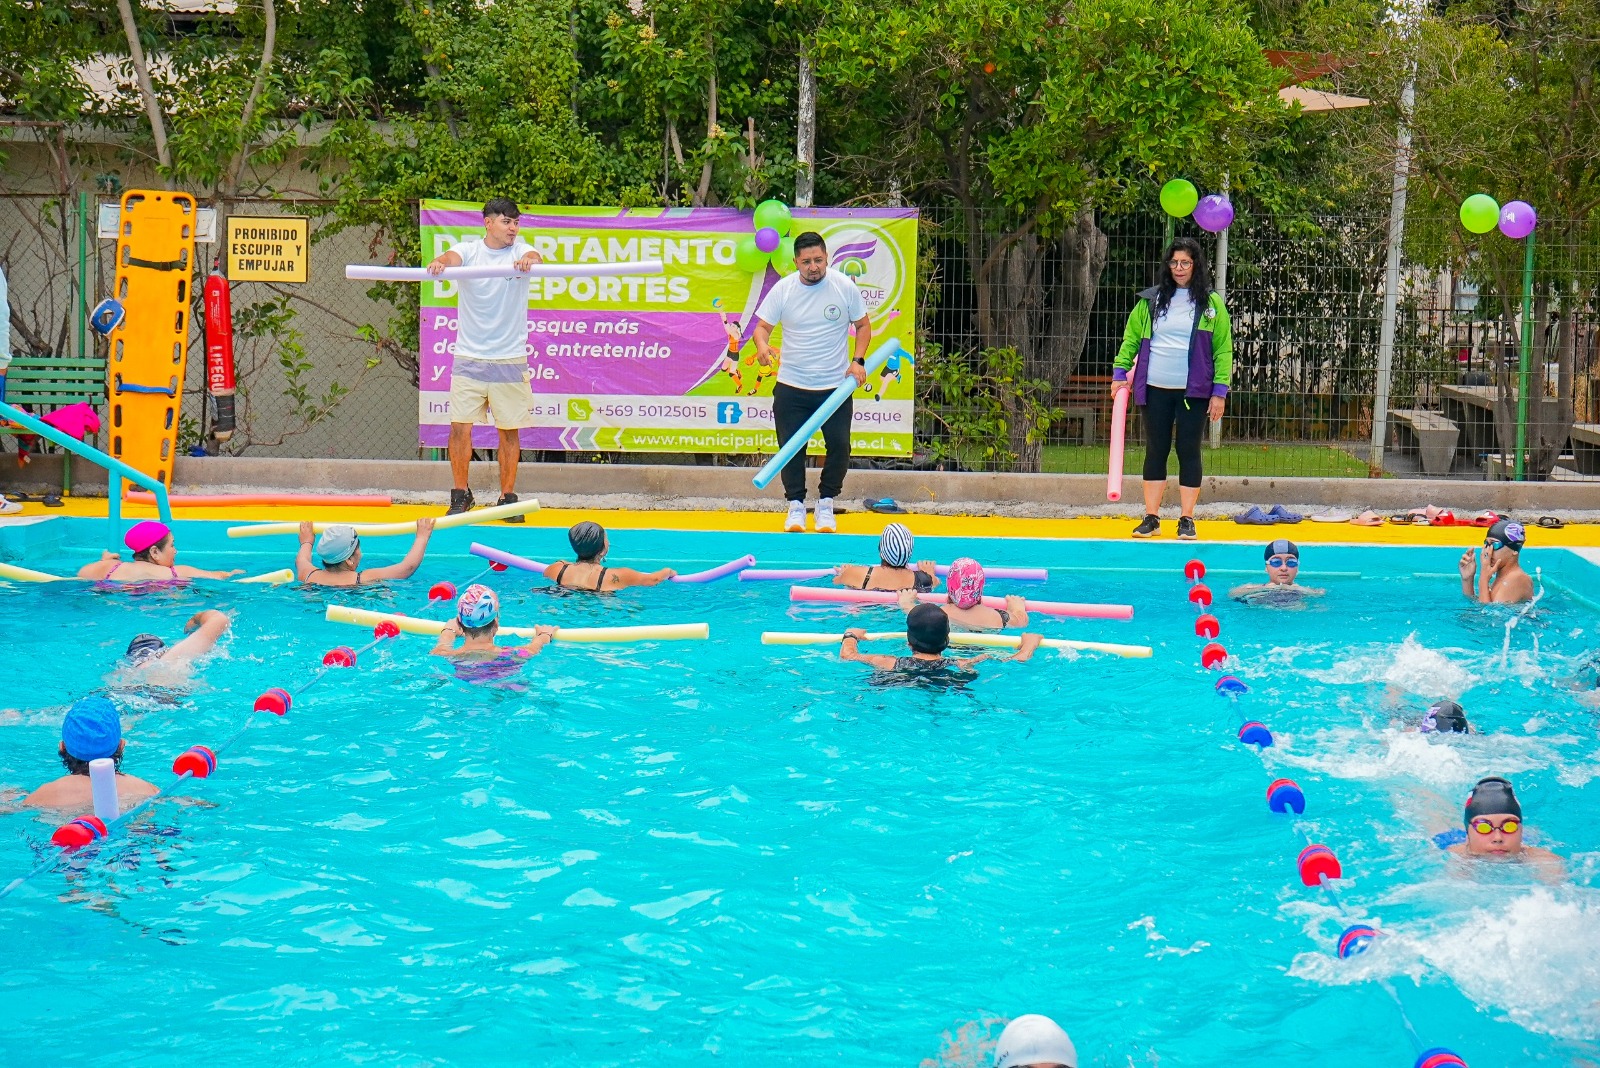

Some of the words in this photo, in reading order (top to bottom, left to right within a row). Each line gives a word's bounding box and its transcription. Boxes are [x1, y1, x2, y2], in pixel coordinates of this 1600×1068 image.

[234, 228, 298, 241] PROHIBIDO
[232, 244, 283, 256] ESCUPIR
[295, 245, 302, 257] Y
[434, 233, 737, 266] DRTAMENTO
[238, 259, 295, 272] EMPUJAR
[528, 276, 690, 304] EPORTES
[861, 289, 885, 300] QUE
[433, 315, 459, 331] Po
[527, 320, 588, 336] osque
[593, 318, 639, 335] más
[545, 341, 672, 359] entretenido
[209, 345, 225, 392] LIFEGU
[431, 365, 447, 381] y
[547, 403, 561, 415] al
[596, 404, 634, 417] +569
[638, 404, 707, 418] 50125015
[853, 410, 902, 424] osque
